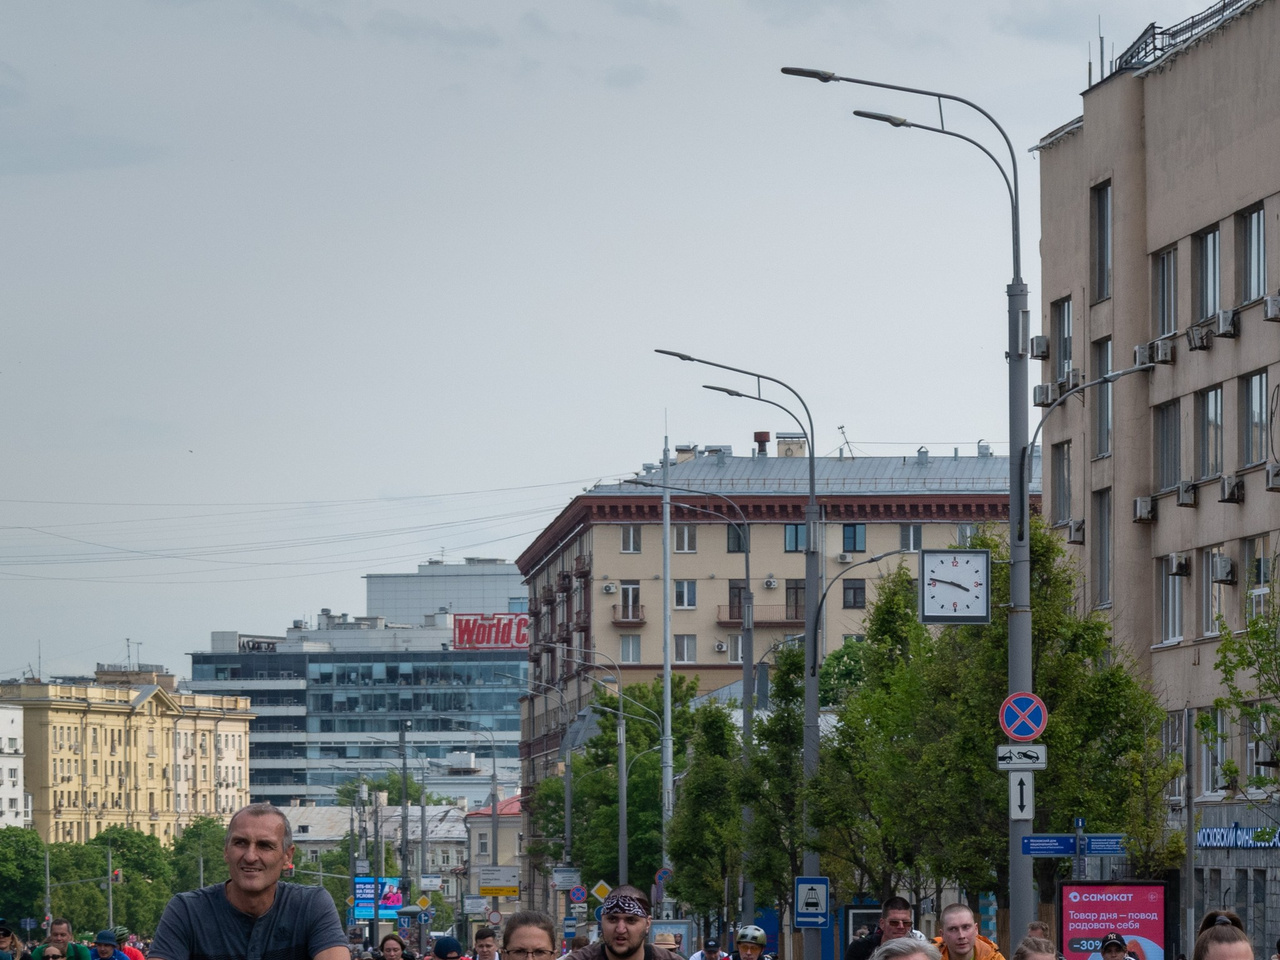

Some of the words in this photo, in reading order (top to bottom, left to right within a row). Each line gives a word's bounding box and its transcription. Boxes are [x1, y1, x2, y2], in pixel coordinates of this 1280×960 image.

[952, 601, 958, 609] 6
[458, 618, 514, 645] World
[1197, 822, 1236, 848] МОСКОВСКИЙ
[1082, 893, 1134, 902] самокат
[1069, 911, 1098, 921] Товар
[1099, 912, 1118, 920] дня
[1128, 912, 1158, 920] повод
[1069, 922, 1115, 931] радовать
[1116, 921, 1140, 929] себя
